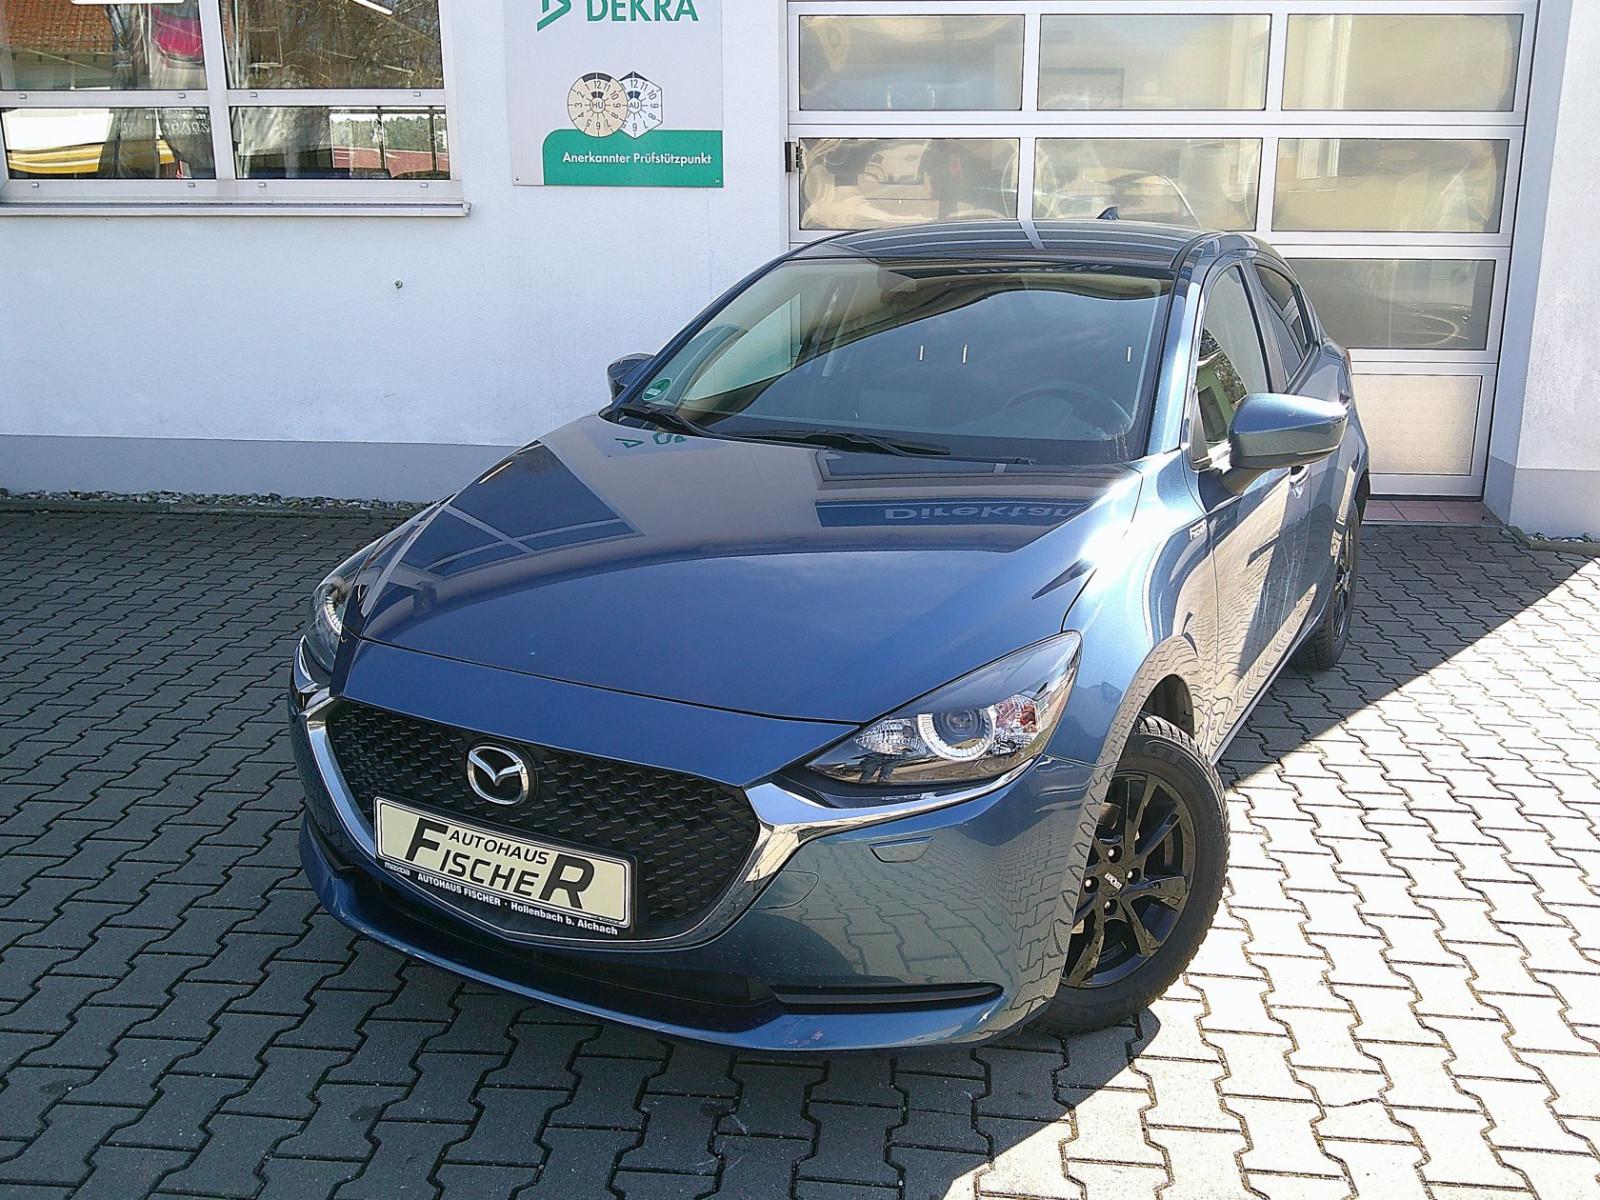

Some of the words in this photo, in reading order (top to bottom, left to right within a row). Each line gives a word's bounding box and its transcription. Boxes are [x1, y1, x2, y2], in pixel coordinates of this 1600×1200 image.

[587, 0, 698, 22] DEKRA
[593, 80, 601, 89] 12
[630, 79, 638, 89] 12
[610, 90, 619, 101] 10
[647, 89, 657, 101] 10
[562, 152, 631, 164] Anerkannter
[633, 152, 712, 167] Prüfstützpunkt
[448, 829, 550, 865] AUTOHAUS
[417, 872, 463, 894] AUTOHAUS
[463, 887, 502, 907] FISCHER
[510, 901, 564, 924] Hollenbach
[565, 916, 575, 926] b.
[577, 918, 619, 936] Aichach
